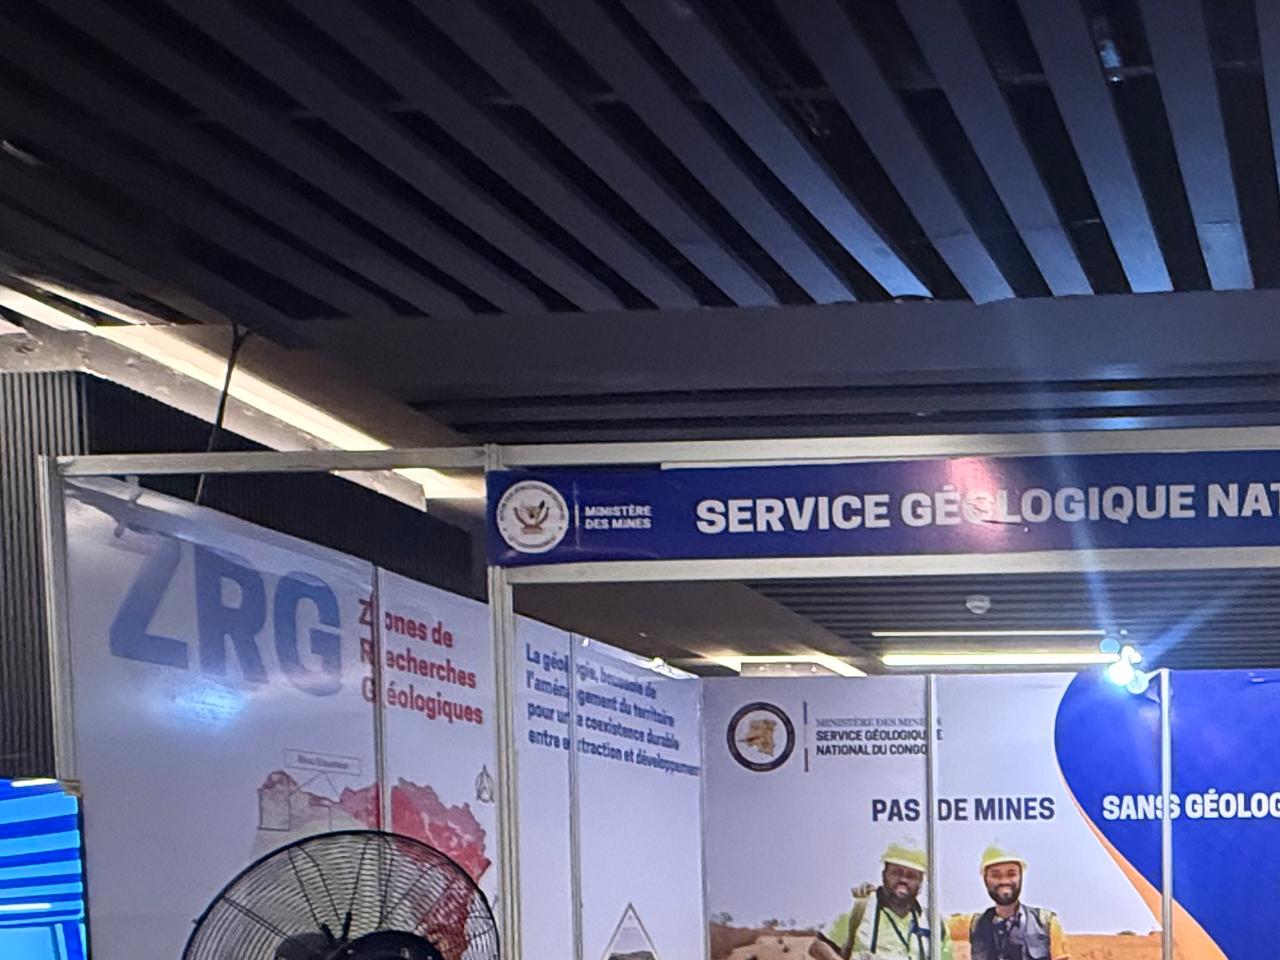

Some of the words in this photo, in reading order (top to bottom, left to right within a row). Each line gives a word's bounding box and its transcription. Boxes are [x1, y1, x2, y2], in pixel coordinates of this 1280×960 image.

[585, 504, 652, 517] MINISTÈRE
[696, 494, 890, 534] SERVICE
[900, 483, 1195, 527] GÉOLOGIQUE
[585, 519, 609, 530] DES
[612, 518, 652, 529] MINES
[108, 536, 343, 697] ZRG
[431, 620, 454, 649] de
[360, 636, 478, 690] Recherches
[526, 642, 541, 665] La
[543, 651, 598, 683] géolgie,
[527, 702, 555, 721] pour
[528, 729, 561, 749] entre
[816, 729, 862, 741] SERVICE
[816, 744, 871, 756] NATIONAL
[873, 744, 887, 755] DU
[889, 743, 927, 756] CONGO
[872, 798, 921, 822] PAS
[938, 798, 968, 821] DE
[974, 797, 1055, 821] MINES
[1102, 794, 1181, 820] SANS
